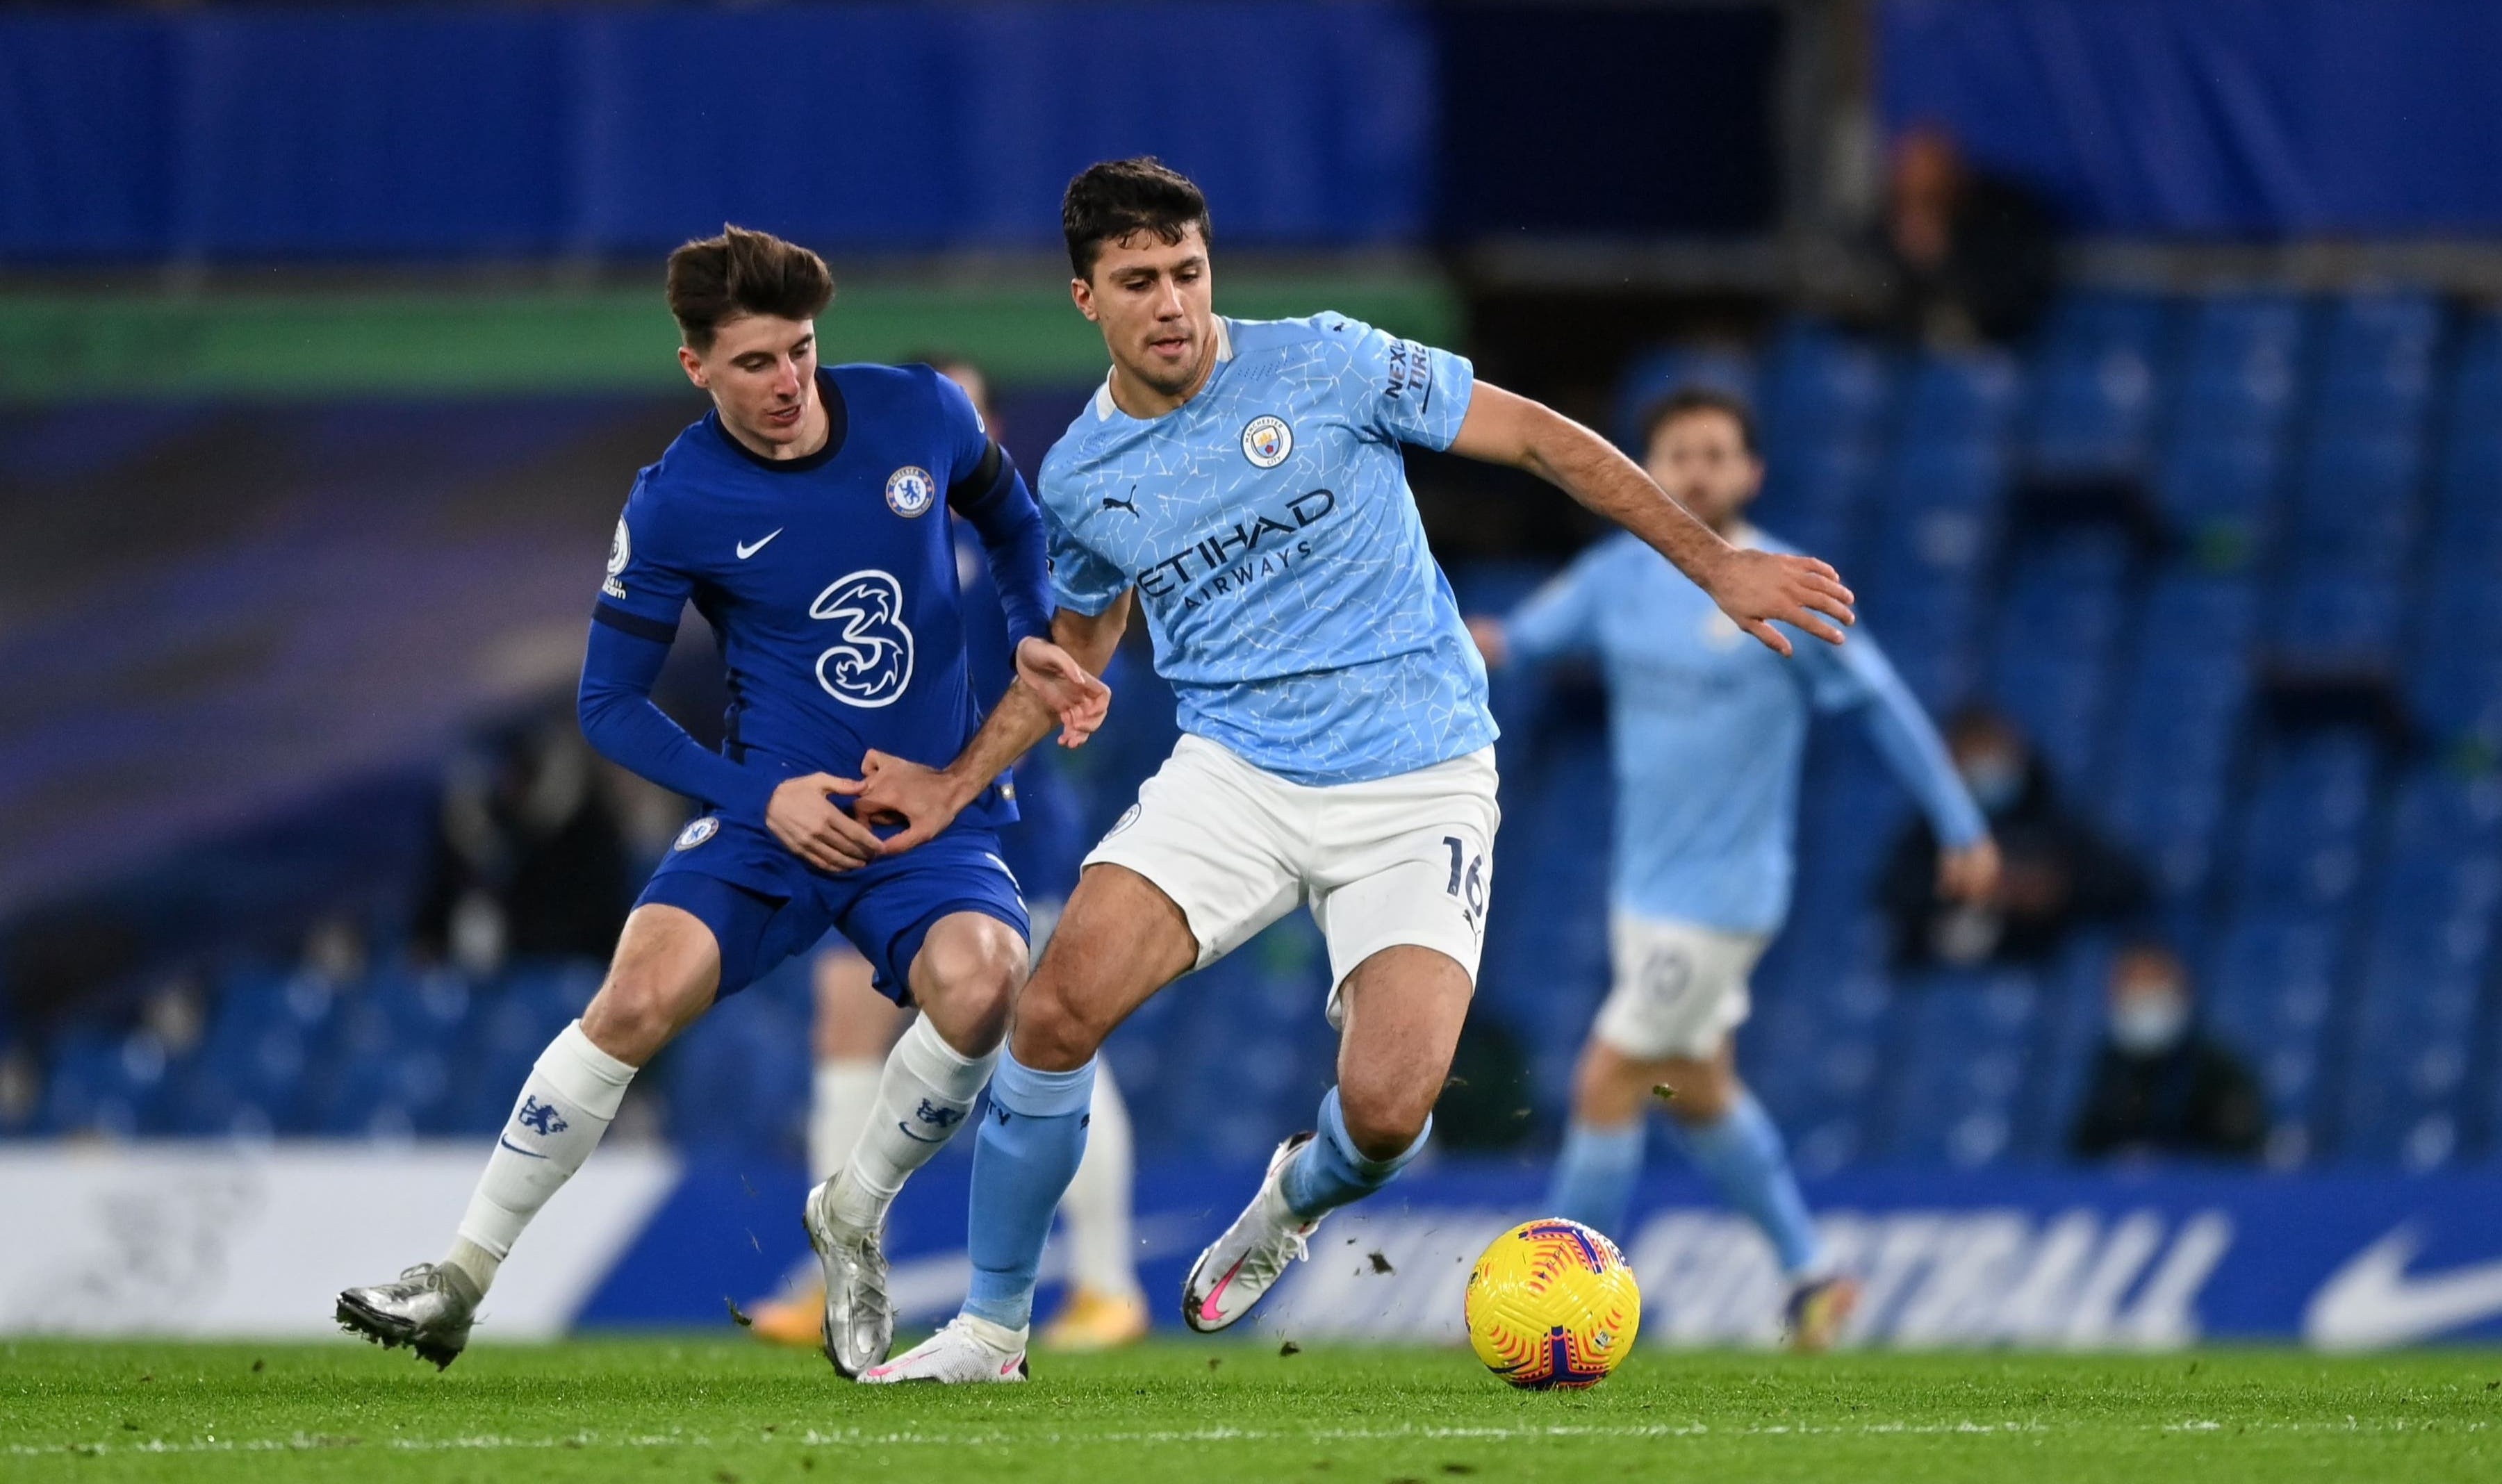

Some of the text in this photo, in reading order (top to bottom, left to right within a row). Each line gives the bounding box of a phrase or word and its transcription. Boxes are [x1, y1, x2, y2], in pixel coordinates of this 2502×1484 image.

[1245, 418, 1283, 443] MANCHESTER
[1267, 456, 1282, 466] CITY
[1137, 488, 1335, 597] ETIHAD
[1184, 541, 1312, 611] AIRWAYS
[809, 569, 914, 708] 3
[1442, 836, 1483, 918] 16
